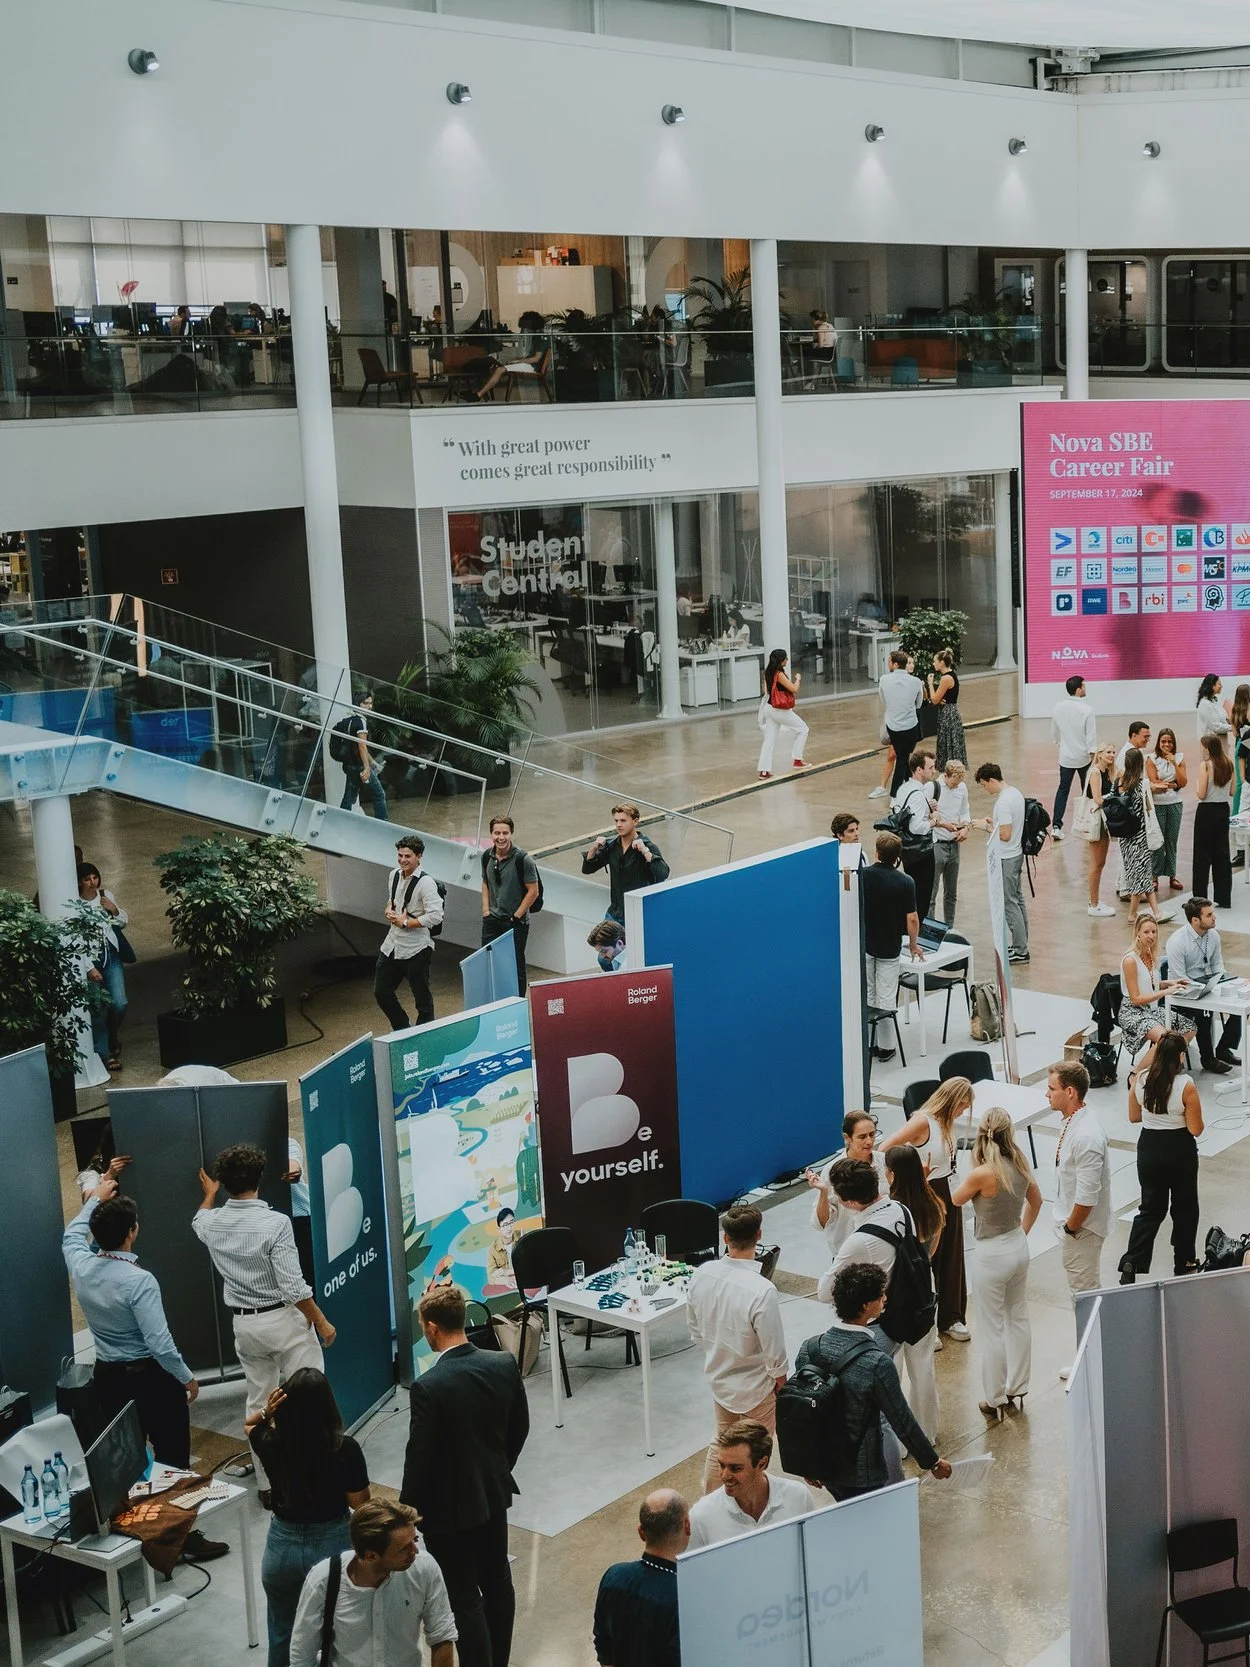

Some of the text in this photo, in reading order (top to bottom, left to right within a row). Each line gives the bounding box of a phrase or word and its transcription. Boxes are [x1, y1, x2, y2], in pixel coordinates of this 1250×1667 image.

[501, 439, 539, 458] great
[545, 437, 592, 456] power
[1049, 431, 1153, 452] Nova SBE
[460, 465, 510, 481] comes
[514, 461, 553, 480] great
[1049, 455, 1174, 477] Career Fair
[1050, 488, 1143, 499] SEPTEMBER 17, 2024
[482, 561, 588, 598] Central
[1145, 593, 1164, 606] rbi
[1051, 646, 1089, 660] NOVA
[627, 985, 658, 997] Roland
[628, 994, 658, 1005] Berger
[350, 1059, 366, 1075] Roland
[350, 1068, 367, 1085] Berger
[560, 1149, 664, 1192] yourself.
[324, 1245, 378, 1298] one of us.
